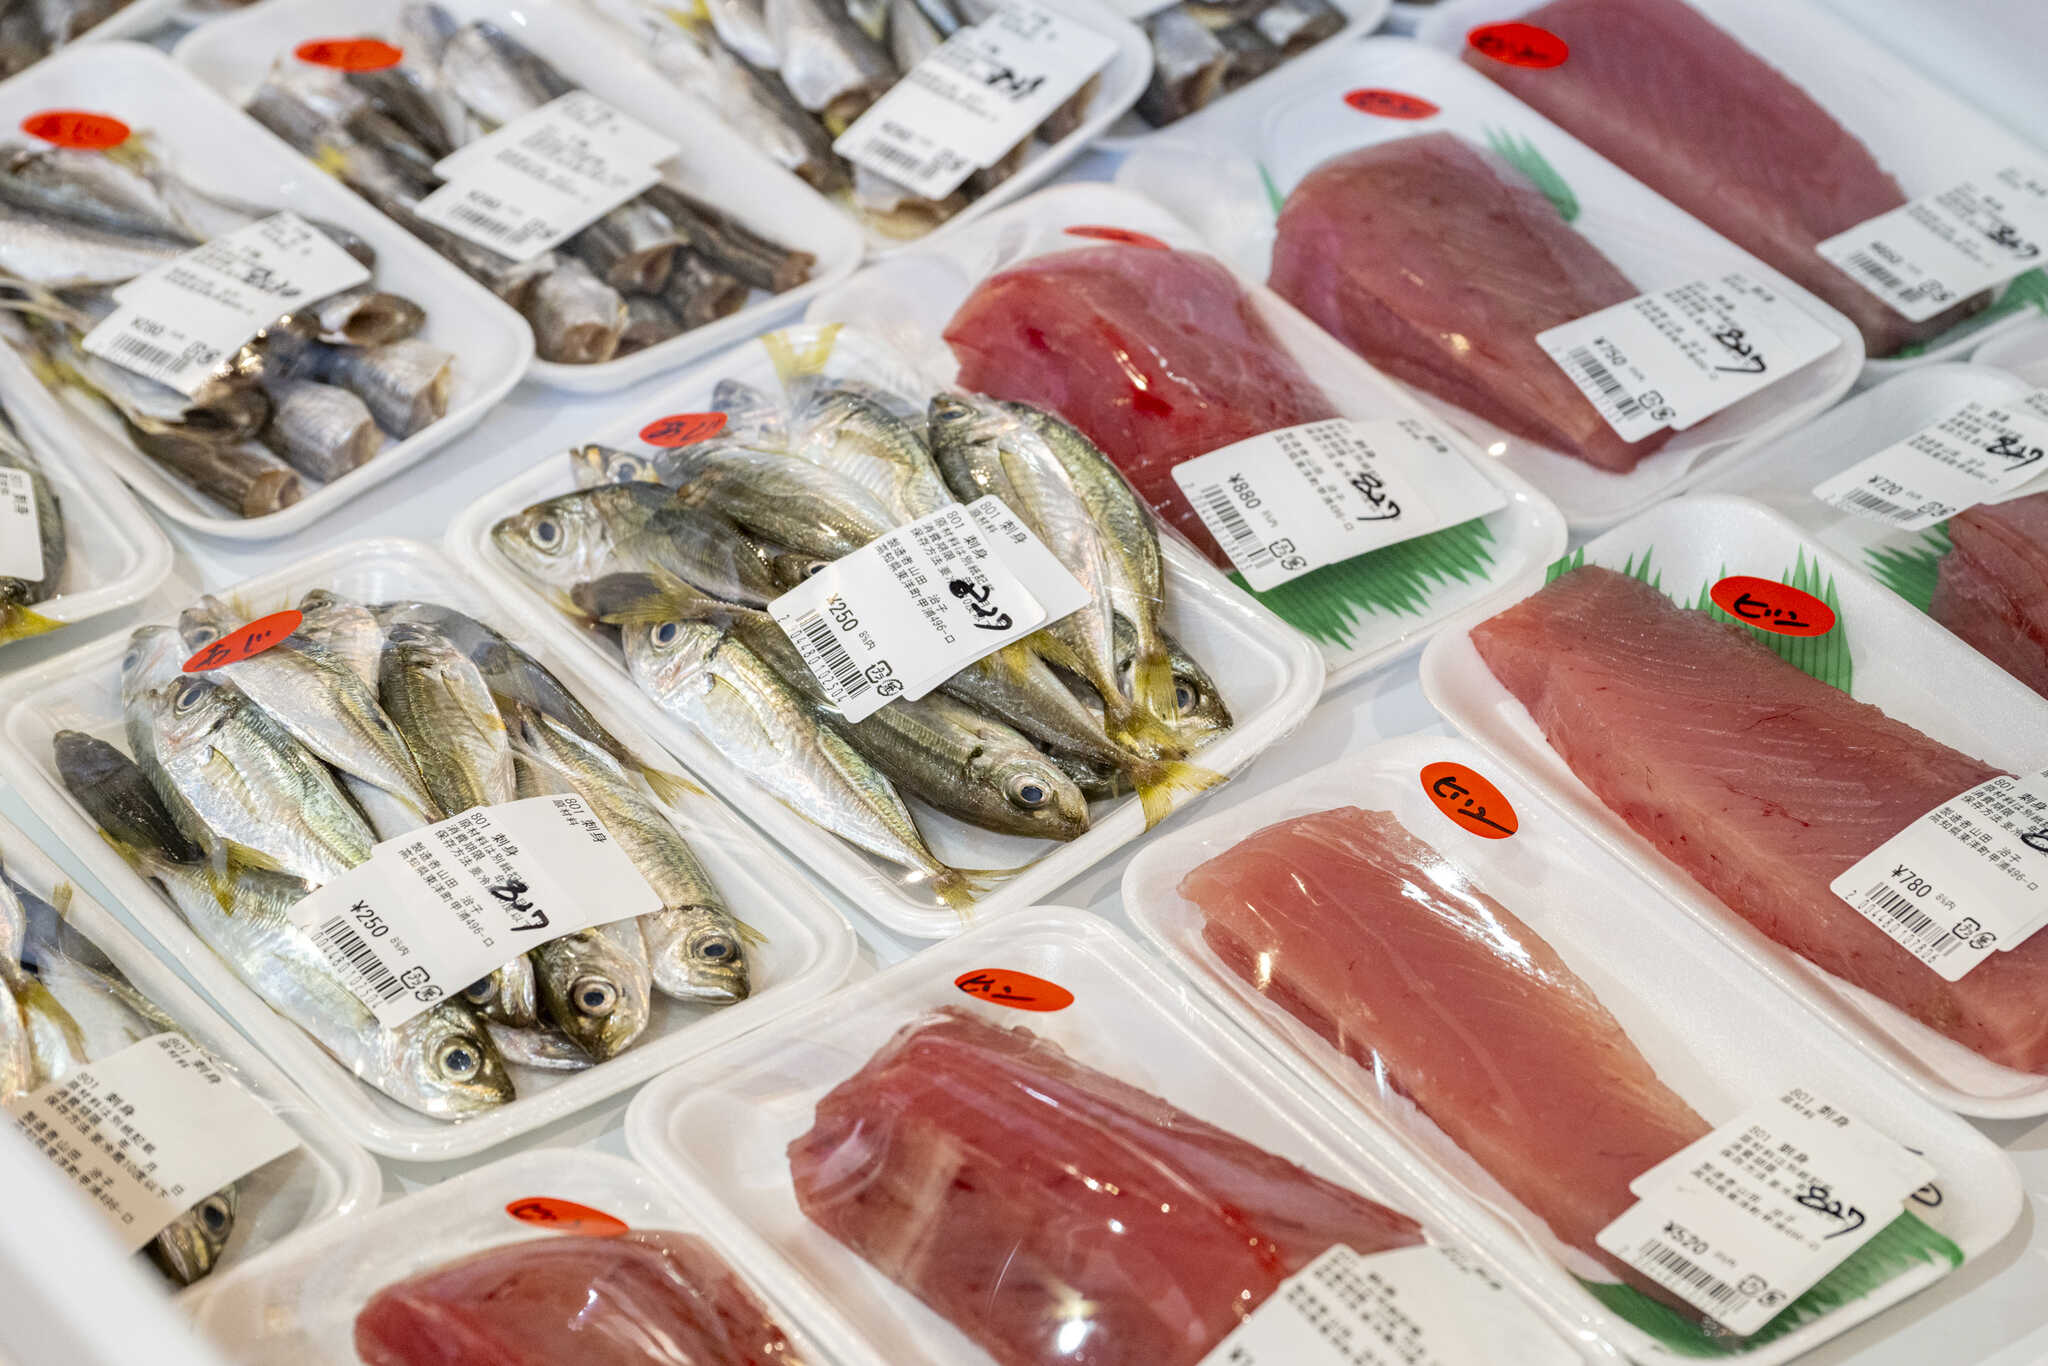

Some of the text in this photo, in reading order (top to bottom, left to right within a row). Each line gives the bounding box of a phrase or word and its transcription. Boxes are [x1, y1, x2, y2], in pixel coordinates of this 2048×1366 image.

[1227, 472, 1262, 509] ¥880
[980, 501, 1000, 519] 801
[947, 510, 988, 560] 801 刺身
[827, 593, 859, 631] ¥250
[194, 630, 271, 670] あじ
[1994, 779, 2015, 791] 801
[564, 799, 585, 814] 801
[471, 812, 519, 857] 801 刺身
[1891, 864, 1932, 898] ¥780
[350, 899, 389, 938] ¥250
[1664, 1220, 1709, 1256] ¥520
